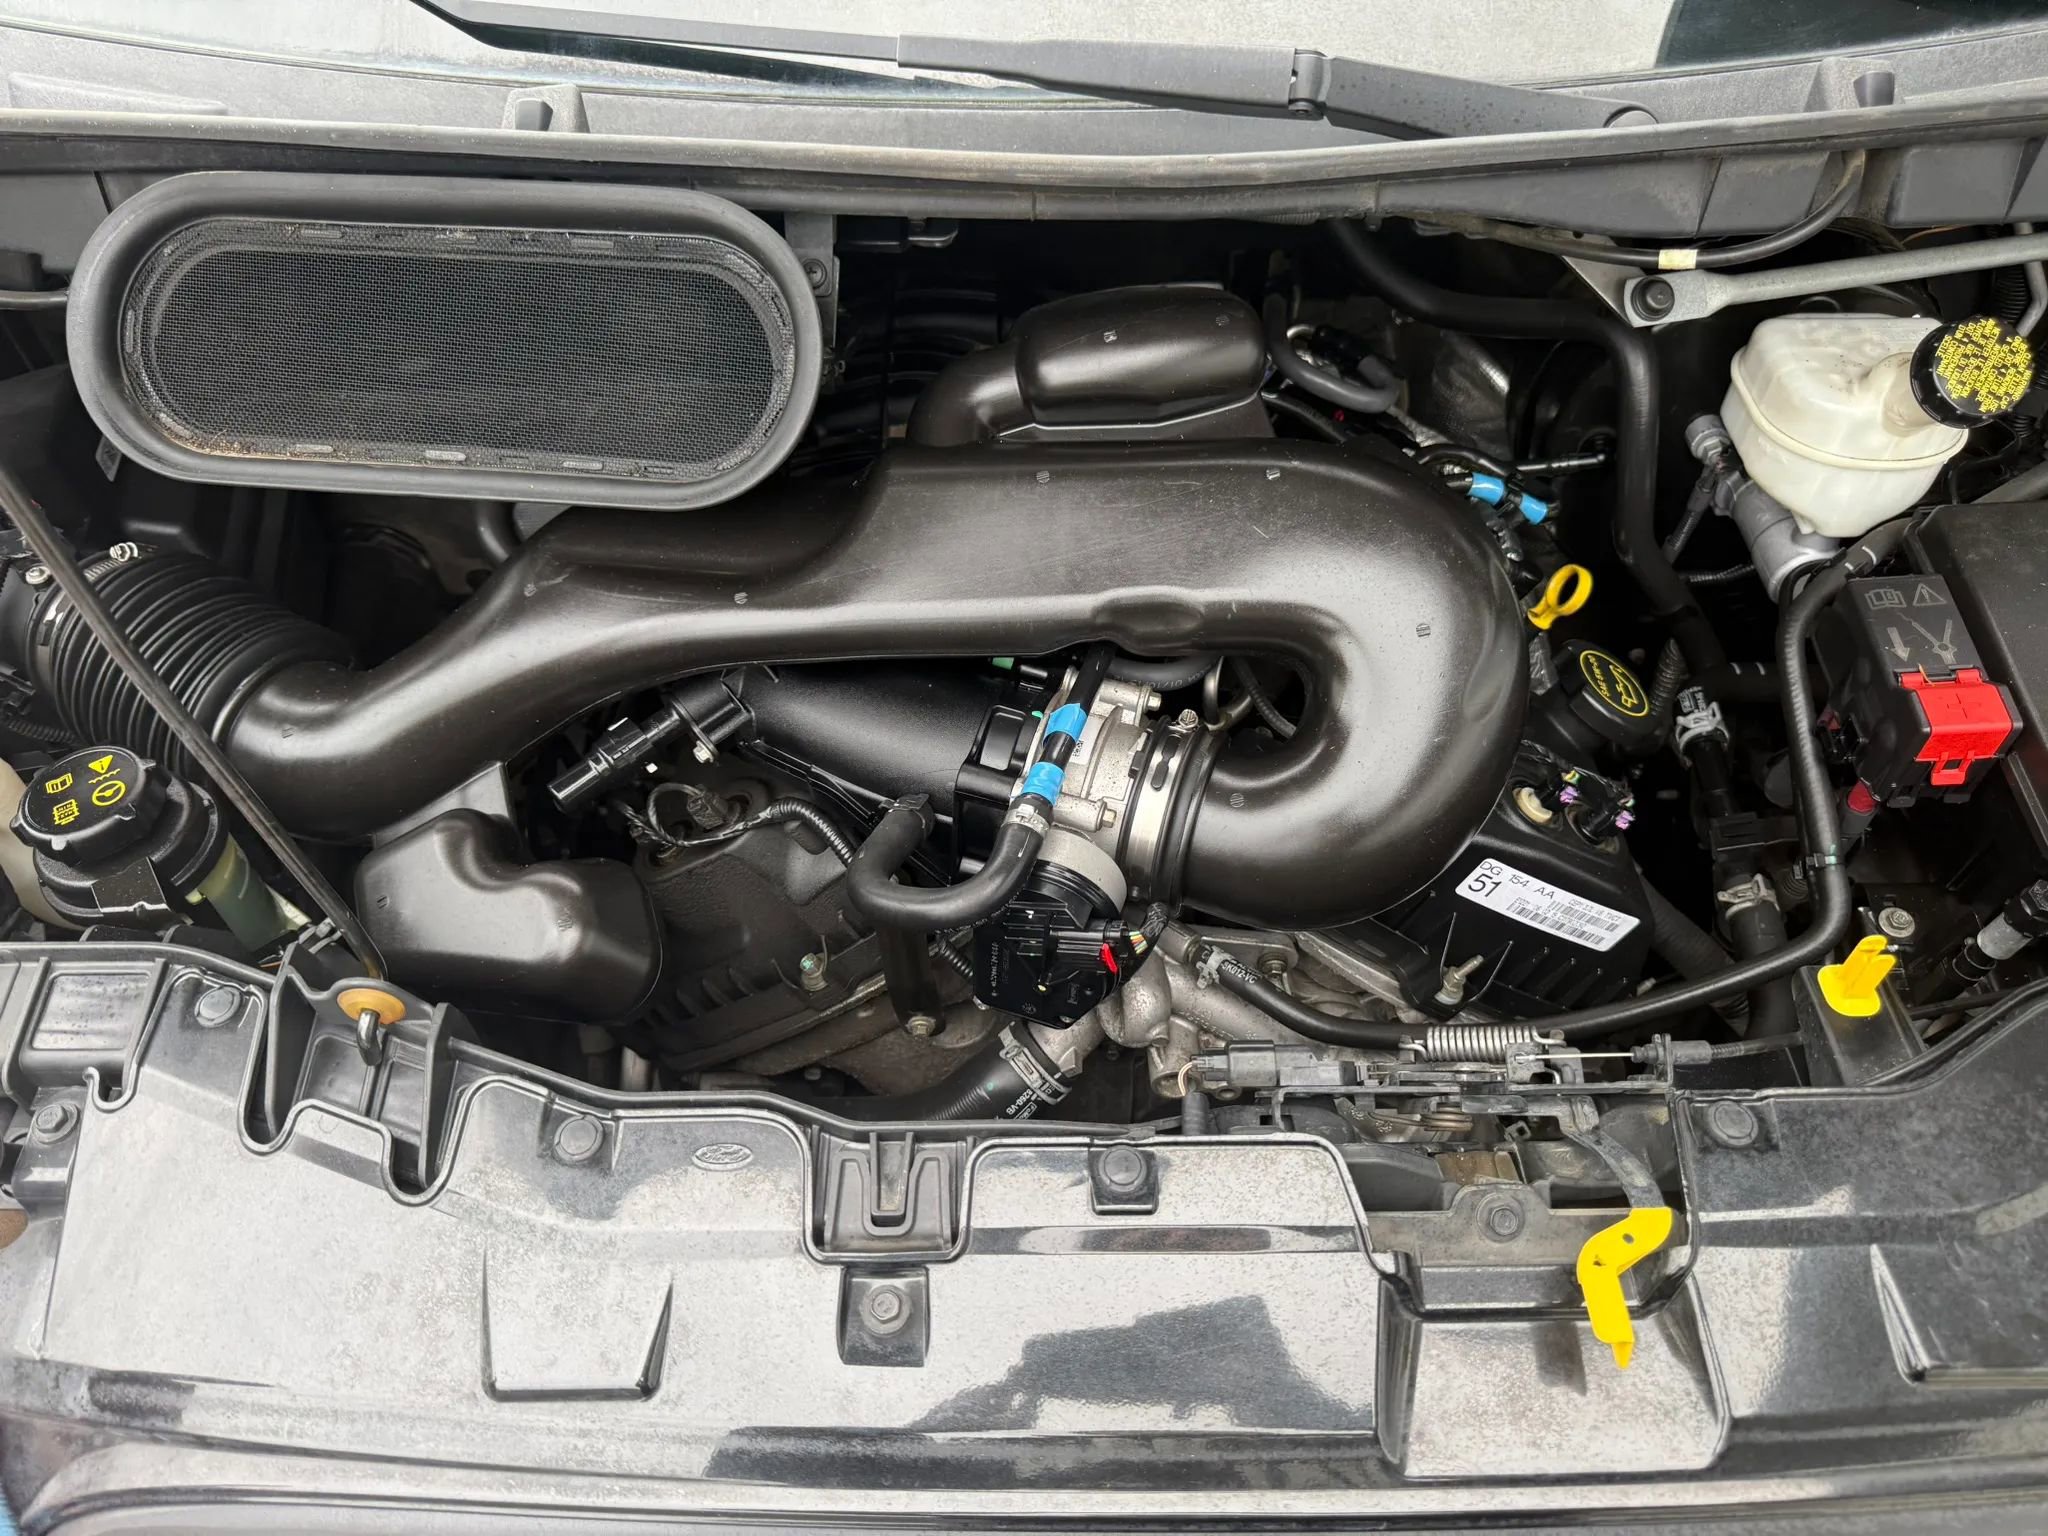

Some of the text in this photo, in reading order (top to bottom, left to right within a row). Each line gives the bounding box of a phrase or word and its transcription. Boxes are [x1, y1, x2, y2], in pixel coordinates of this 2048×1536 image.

[1964, 321, 1976, 335] DOT
[1970, 318, 1986, 342] PLOYER
[1962, 342, 1974, 356] QUE
[1980, 326, 2000, 356] NETTOYER
[2009, 335, 2022, 352] ONLY
[1934, 339, 1958, 376] CONTENANT
[1941, 343, 1965, 380] PROVENANT
[1993, 343, 2009, 367] SEALED
[2002, 352, 2014, 366] DOT
[2011, 342, 2027, 366] BEFORE
[1944, 368, 1961, 391] LIQUIDE
[1959, 368, 1979, 398] BOUCHON
[1988, 374, 2002, 393] FLUID
[1997, 351, 2031, 410] CLEAN FILLER CAP
[1978, 393, 1993, 412] FROM
[1987, 399, 1999, 413] USE
[1468, 873, 1502, 898] 51
[1480, 861, 1555, 899] DG 154 AA
